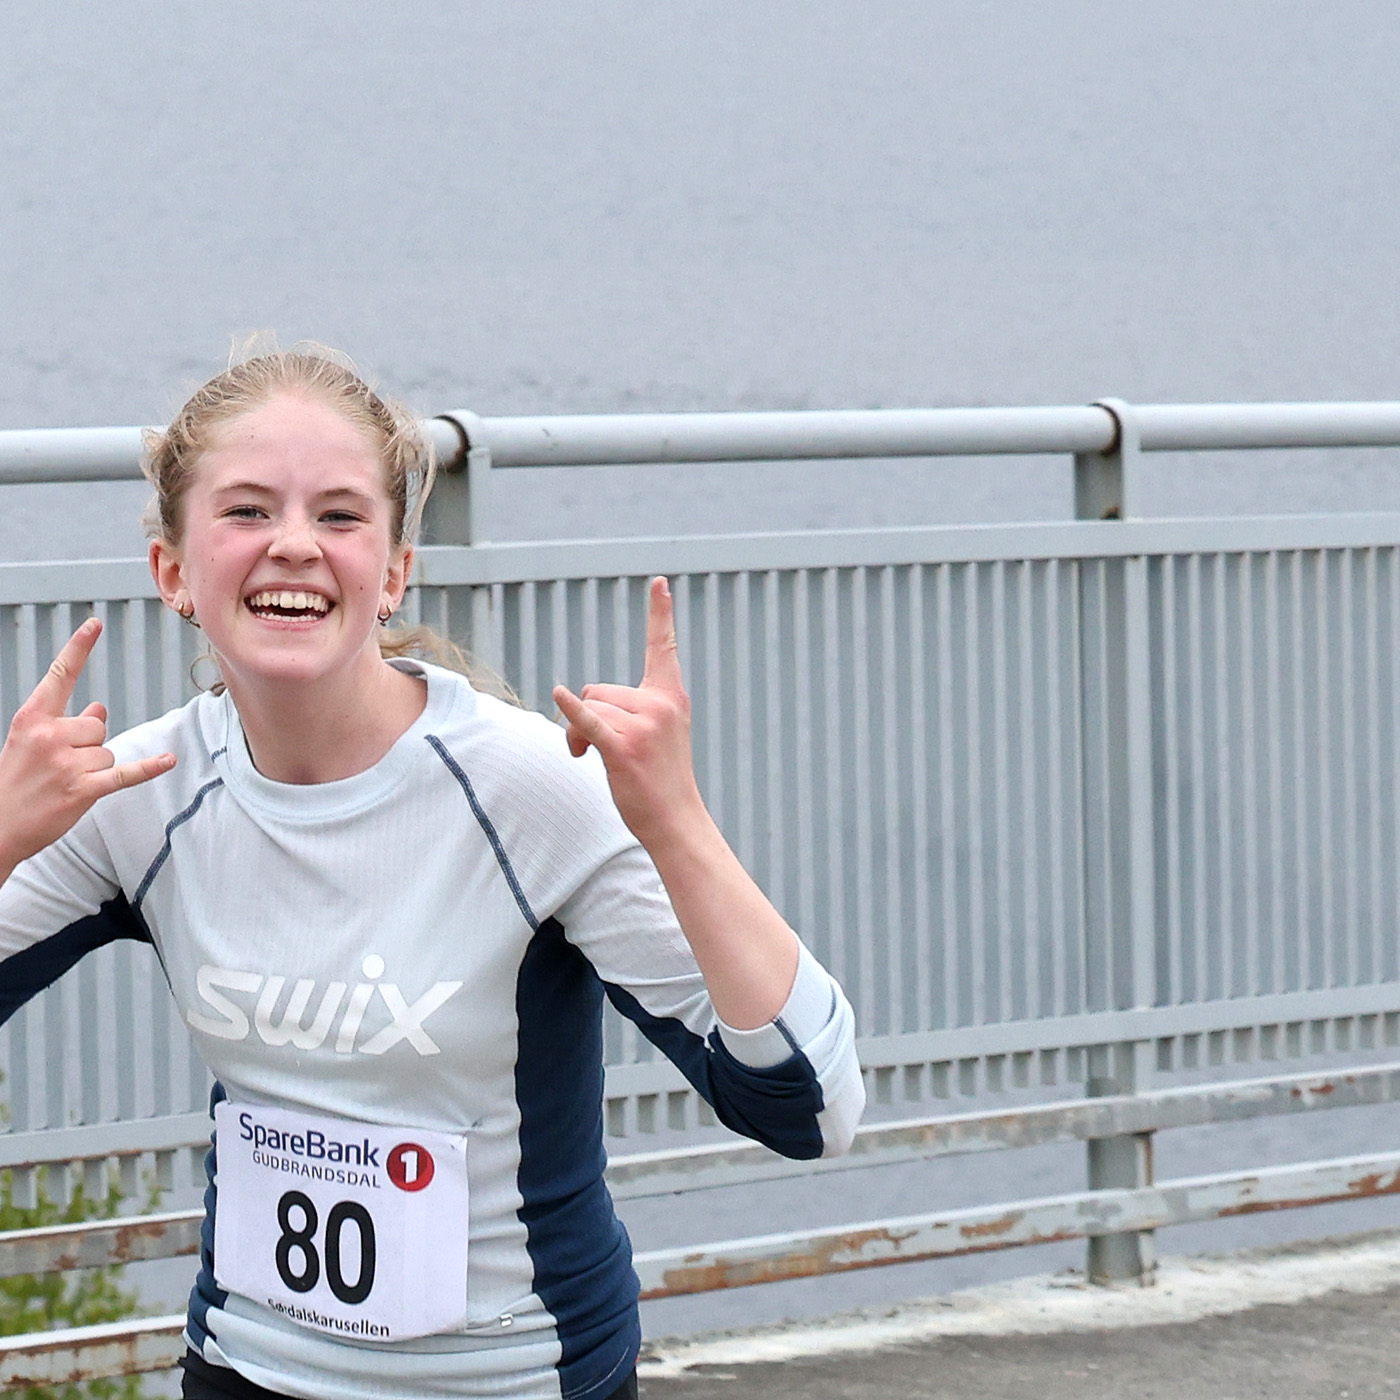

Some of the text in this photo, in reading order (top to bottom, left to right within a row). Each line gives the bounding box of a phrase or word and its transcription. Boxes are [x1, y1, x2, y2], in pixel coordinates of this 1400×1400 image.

[239, 1112, 381, 1168] SpareBank
[252, 1150, 382, 1189] GUDBRANDSDAL
[275, 1190, 377, 1306] 80
